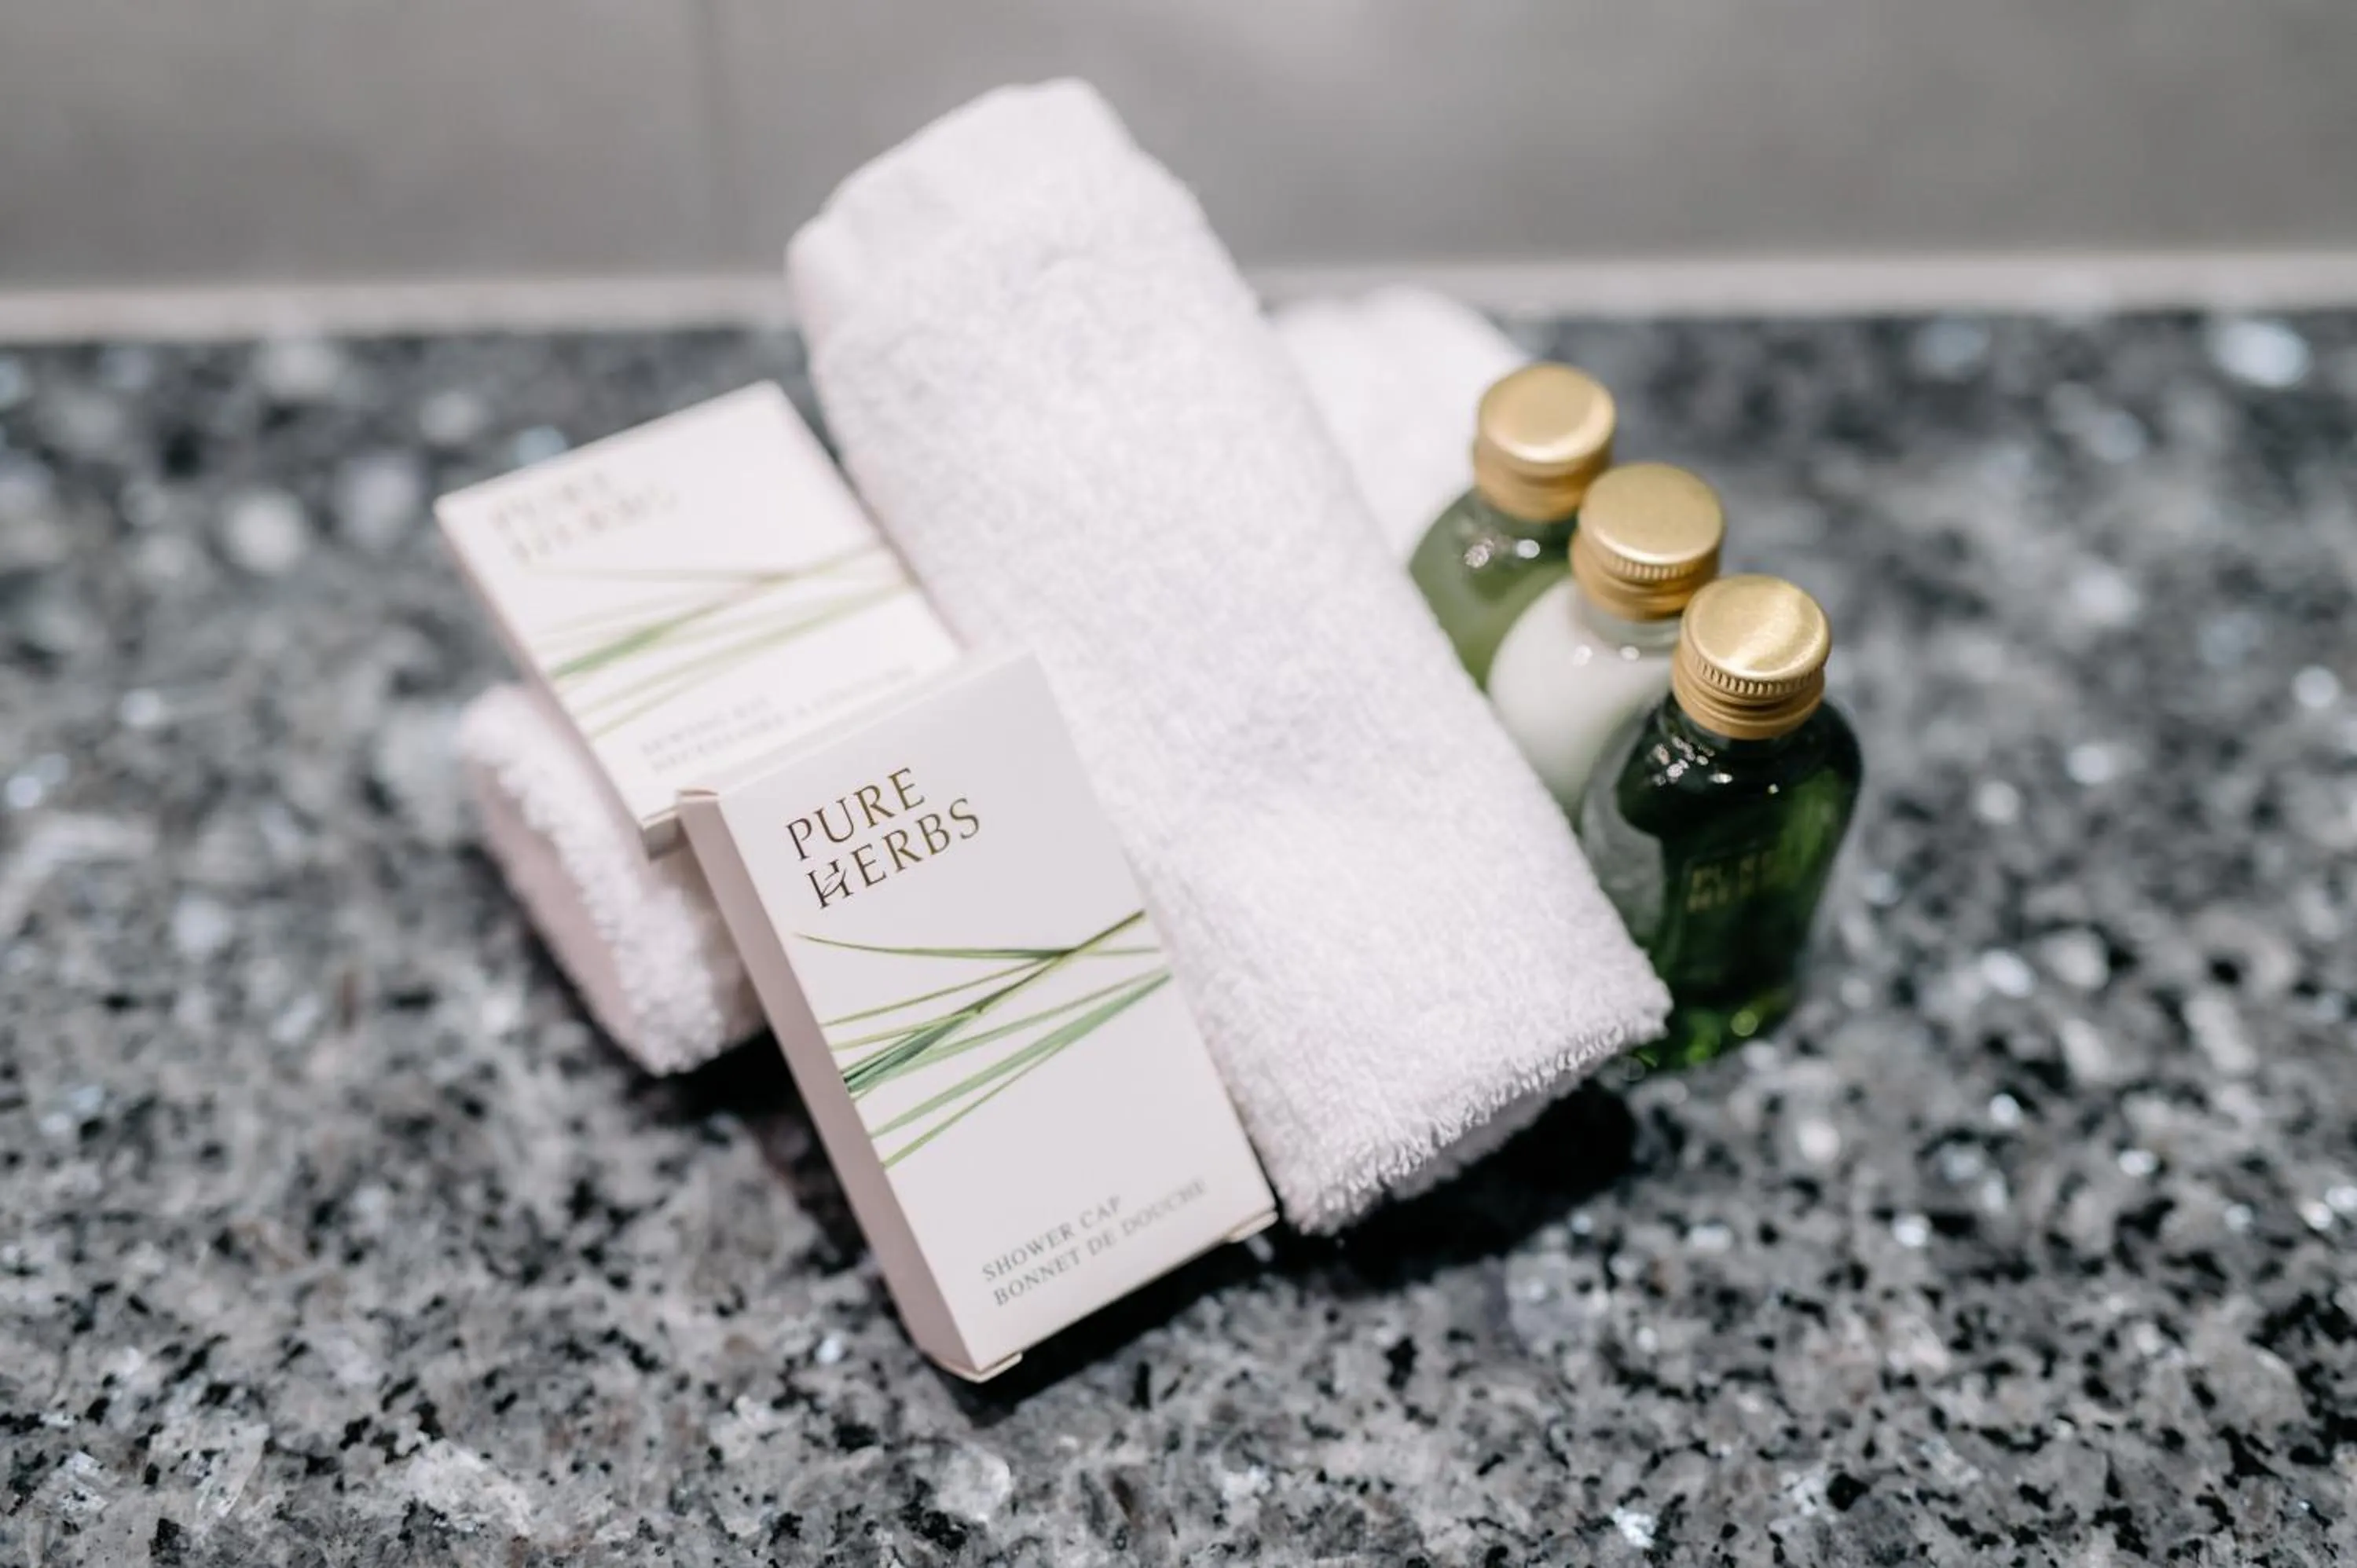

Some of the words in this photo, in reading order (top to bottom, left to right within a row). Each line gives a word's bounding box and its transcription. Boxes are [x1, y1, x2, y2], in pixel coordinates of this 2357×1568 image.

[785, 767, 926, 861] PURE
[805, 797, 981, 910] HERBS
[981, 1222, 1075, 1282] SHOWER
[1079, 1194, 1122, 1229] CAP
[992, 1245, 1081, 1307] BONNET
[1087, 1227, 1116, 1257] DE
